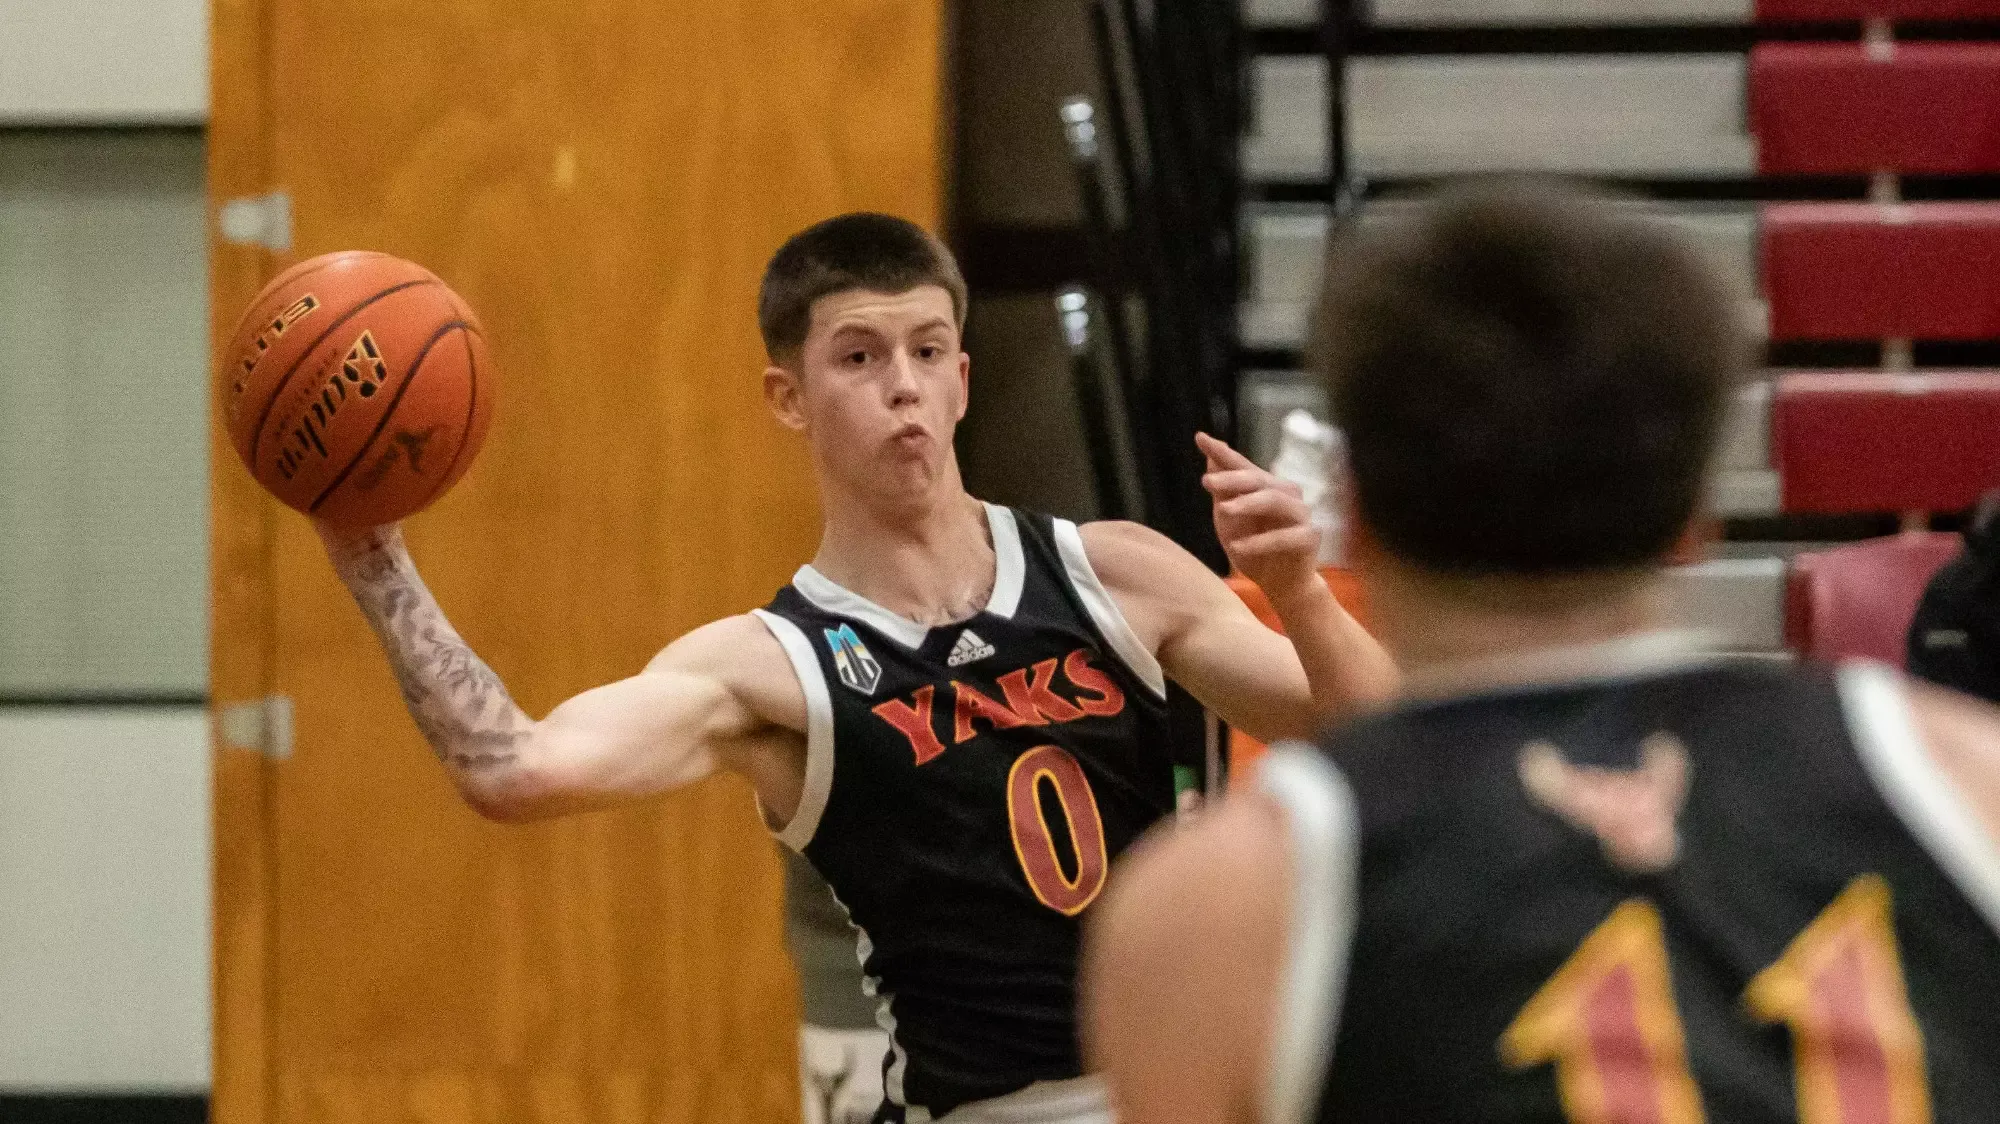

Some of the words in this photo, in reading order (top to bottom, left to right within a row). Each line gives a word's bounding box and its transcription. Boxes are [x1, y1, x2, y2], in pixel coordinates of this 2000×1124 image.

[275, 329, 388, 481] Baden
[871, 648, 1125, 767] YAKS
[947, 643, 996, 667] adidas
[1006, 744, 1108, 916] 0
[1498, 872, 1932, 1124] 11
